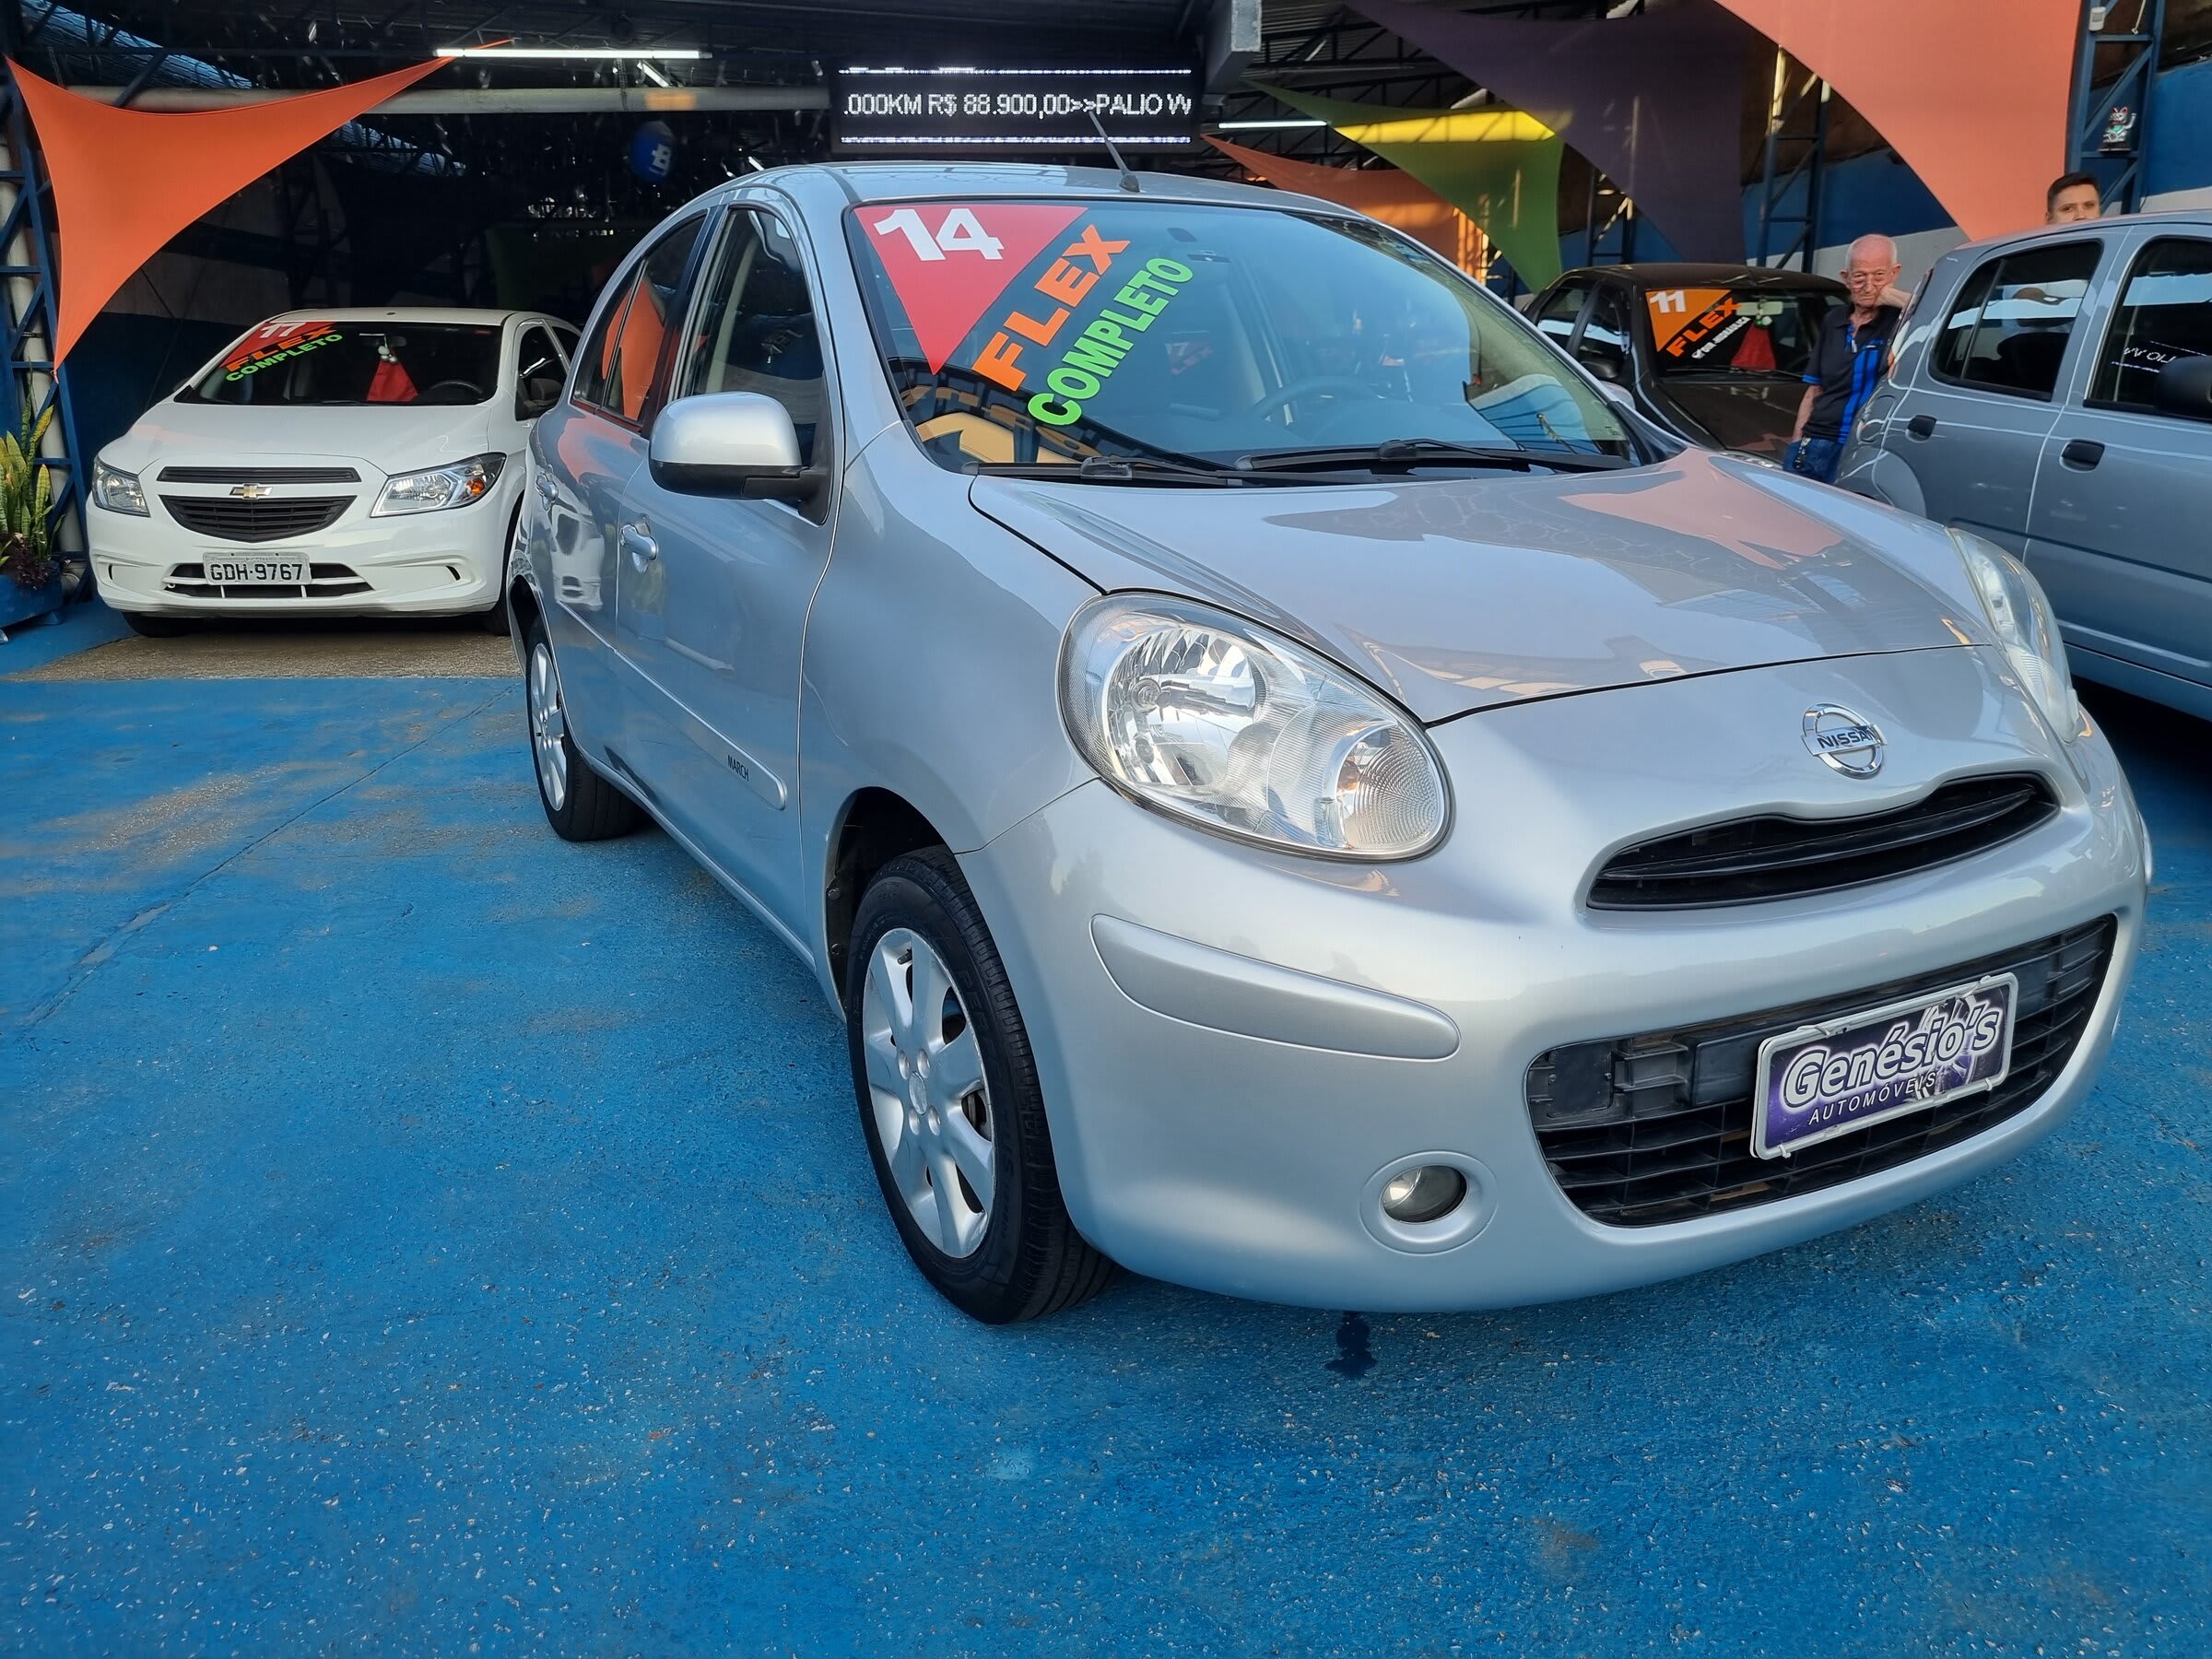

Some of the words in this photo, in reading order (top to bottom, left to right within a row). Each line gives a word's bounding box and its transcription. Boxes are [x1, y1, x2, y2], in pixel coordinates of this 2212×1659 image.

[927, 93, 958, 117] R$
[873, 207, 1006, 262] 14
[971, 224, 1131, 392] FLEX
[1649, 290, 1687, 314] 11
[226, 325, 337, 372] FLEX
[259, 322, 308, 339] 17
[1027, 257, 1194, 426] COMPLETO
[1665, 297, 1741, 358] FLEX
[225, 334, 344, 382] COMPLETO
[1817, 728, 1877, 749] NISSAN
[727, 754, 749, 782] MARCH
[1783, 1002, 2001, 1108] Genésio's
[1807, 1071, 1937, 1126] AUTOMÓVEIS
